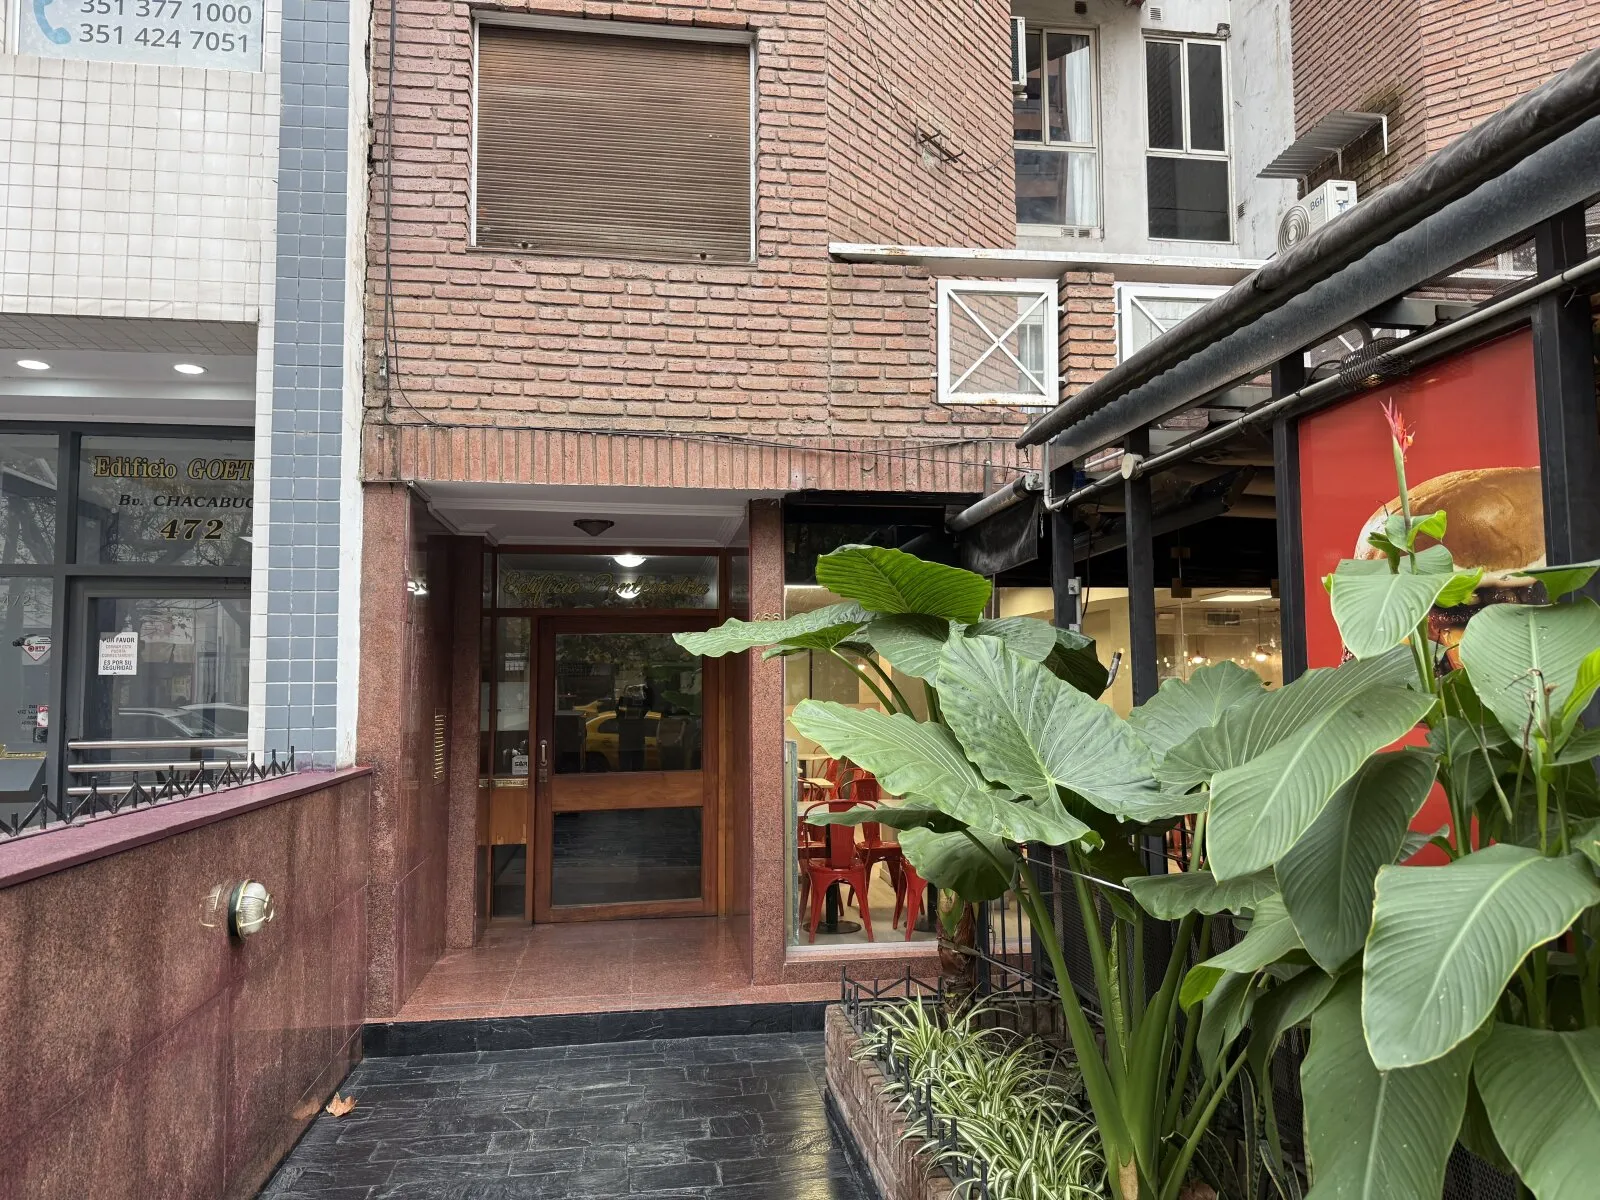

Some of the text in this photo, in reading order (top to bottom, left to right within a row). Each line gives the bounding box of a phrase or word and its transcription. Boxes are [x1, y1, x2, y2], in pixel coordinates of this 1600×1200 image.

[80, 0, 252, 24] 351 377 1000
[79, 23, 248, 53] 351 424 7051
[1310, 194, 1325, 211] BGH
[94, 456, 178, 478] Edificio
[118, 494, 144, 506] Bv.
[160, 518, 224, 541] 472
[502, 572, 711, 605] Edificio Pontevedra
